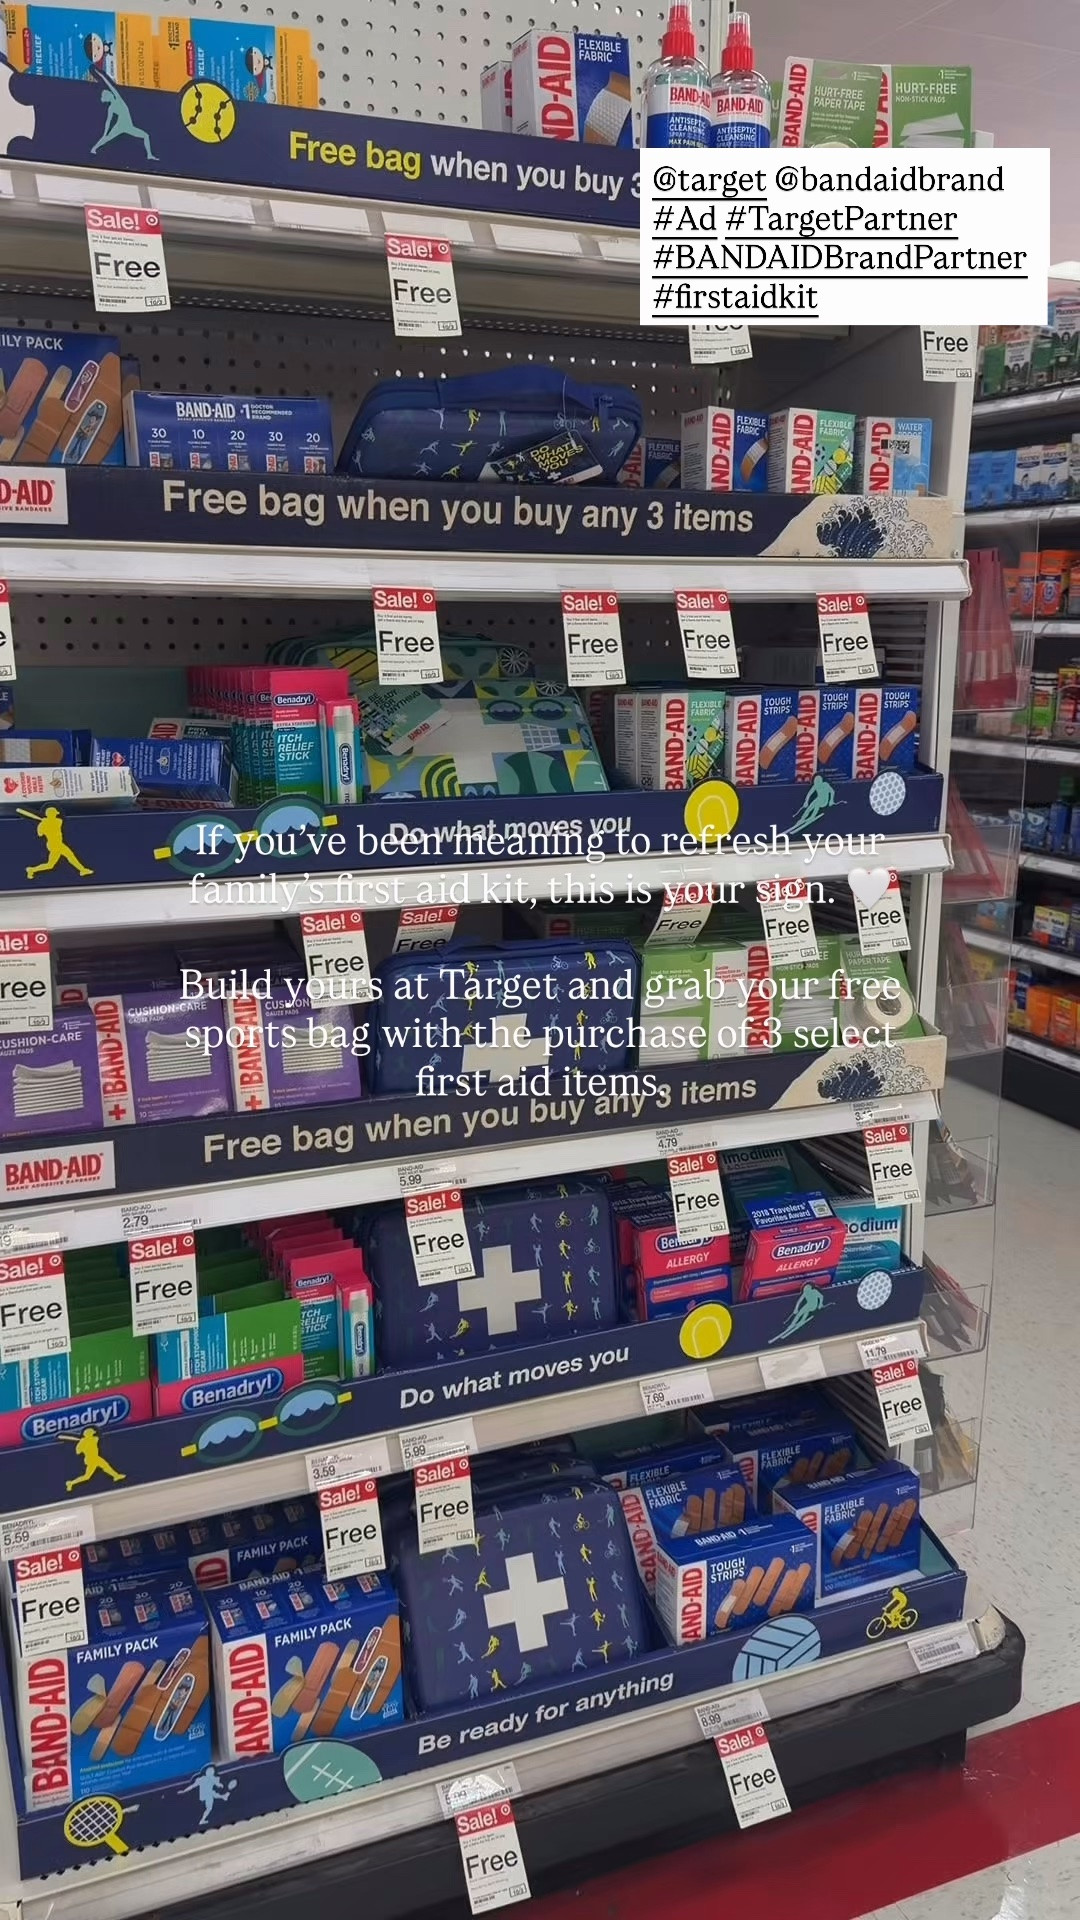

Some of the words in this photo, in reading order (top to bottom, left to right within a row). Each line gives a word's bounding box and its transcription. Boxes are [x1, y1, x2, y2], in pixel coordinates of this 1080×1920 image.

[578, 39, 622, 53] FLEXIBLE
[579, 51, 613, 63] FABRIC
[815, 86, 863, 100] HURT-FREE
[896, 83, 957, 95] HURT-FREE
[717, 98, 763, 113] BAND-AID
[814, 98, 842, 110] PAPER
[844, 100, 866, 112] TAPE
[896, 96, 927, 104] NON-STICK
[929, 96, 946, 104] PADS
[290, 130, 357, 166] Free
[367, 141, 422, 179] bag
[431, 151, 508, 183] when
[517, 164, 566, 192] you
[575, 166, 624, 201] buy
[89, 209, 140, 231] Sale!
[95, 252, 161, 280] Free
[924, 331, 969, 353] Free
[176, 402, 236, 419] BAND-AID
[737, 415, 766, 429] FLEXIBLE
[737, 424, 760, 436] FABRIC
[898, 423, 923, 432] WATER
[152, 428, 167, 439] 30
[193, 429, 205, 440] 10
[231, 430, 245, 441] 20
[269, 432, 283, 442] 30
[307, 433, 321, 443] 20
[164, 480, 247, 515] Free
[260, 485, 325, 526] bag
[338, 490, 430, 522] when
[441, 500, 502, 531] you
[514, 496, 573, 535] buy
[582, 504, 638, 537] any
[647, 502, 663, 531] 3
[674, 502, 753, 532] items
[375, 590, 418, 609] Sale!
[677, 594, 715, 609] Sale!
[379, 631, 434, 653] Free
[683, 630, 731, 649] Free
[277, 696, 312, 705] Benadryl
[765, 698, 791, 706] TOUGH
[764, 706, 792, 715] STRIPS
[278, 734, 302, 743] ITCH
[278, 742, 314, 753] RELIEF
[389, 823, 425, 846] Do
[434, 820, 496, 842] what
[505, 820, 583, 839] moves
[591, 817, 632, 839] you
[303, 913, 347, 932] Sale!
[310, 953, 365, 977] Free
[129, 1001, 207, 1018] CUSHION-CARE
[97, 1000, 127, 1096] BAND-AID
[205, 1133, 282, 1163] Free
[294, 1124, 355, 1154] bag
[366, 1113, 451, 1142] when
[463, 1107, 519, 1138] you
[531, 1099, 586, 1126] buy
[595, 1094, 646, 1118] any
[657, 1083, 672, 1109] 3
[683, 1078, 758, 1106] items
[658, 1138, 678, 1149] 4.79
[6, 1154, 101, 1185] BAND-AID
[400, 1175, 422, 1187] 5.99
[407, 1195, 447, 1214] Sale!
[123, 1216, 149, 1229] 2.79
[752, 1209, 769, 1219] 2018
[755, 1214, 787, 1225] Favorites
[789, 1209, 811, 1220] Award
[131, 1239, 178, 1260] Sale!
[413, 1232, 465, 1255] Free
[777, 1240, 826, 1257] Benadryl
[666, 1252, 710, 1269] ALLERGY
[776, 1257, 821, 1273] ALLERGY
[136, 1278, 193, 1303] Free
[401, 1389, 434, 1409] Do
[442, 1370, 502, 1400] what
[509, 1359, 583, 1386] moves
[590, 1346, 630, 1372] you
[193, 1377, 273, 1409] Benadryl
[645, 1393, 665, 1405] 7.69
[33, 1402, 120, 1436] Benadryl
[405, 1445, 426, 1459] 5.99
[313, 1465, 336, 1478] 3.59
[321, 1486, 361, 1508] Sale!
[646, 1481, 688, 1500] FLEXIBLE
[649, 1494, 683, 1510] FABRIC
[825, 1498, 865, 1516] FLEXIBLE
[825, 1509, 857, 1525] FABRIC
[4, 1532, 30, 1546] 5.59
[326, 1522, 377, 1550] Free
[17, 1557, 64, 1579] Sale!
[711, 1557, 746, 1574] TOUGH
[711, 1568, 745, 1584] STRIPS
[22, 1597, 80, 1624] Free
[275, 1628, 318, 1647] FAMILY
[321, 1618, 353, 1636] PACK
[77, 1645, 122, 1664] FAMILY
[126, 1637, 159, 1654] PACK
[419, 1733, 452, 1756] Be
[460, 1714, 529, 1743] ready
[536, 1704, 567, 1723] for
[576, 1672, 674, 1713] anything
[29, 1657, 69, 1793] BAND-AID
[719, 1733, 753, 1756] Sale!
[730, 1767, 776, 1796] Free
[458, 1812, 499, 1834] Sale!
[467, 1849, 518, 1879] Free
